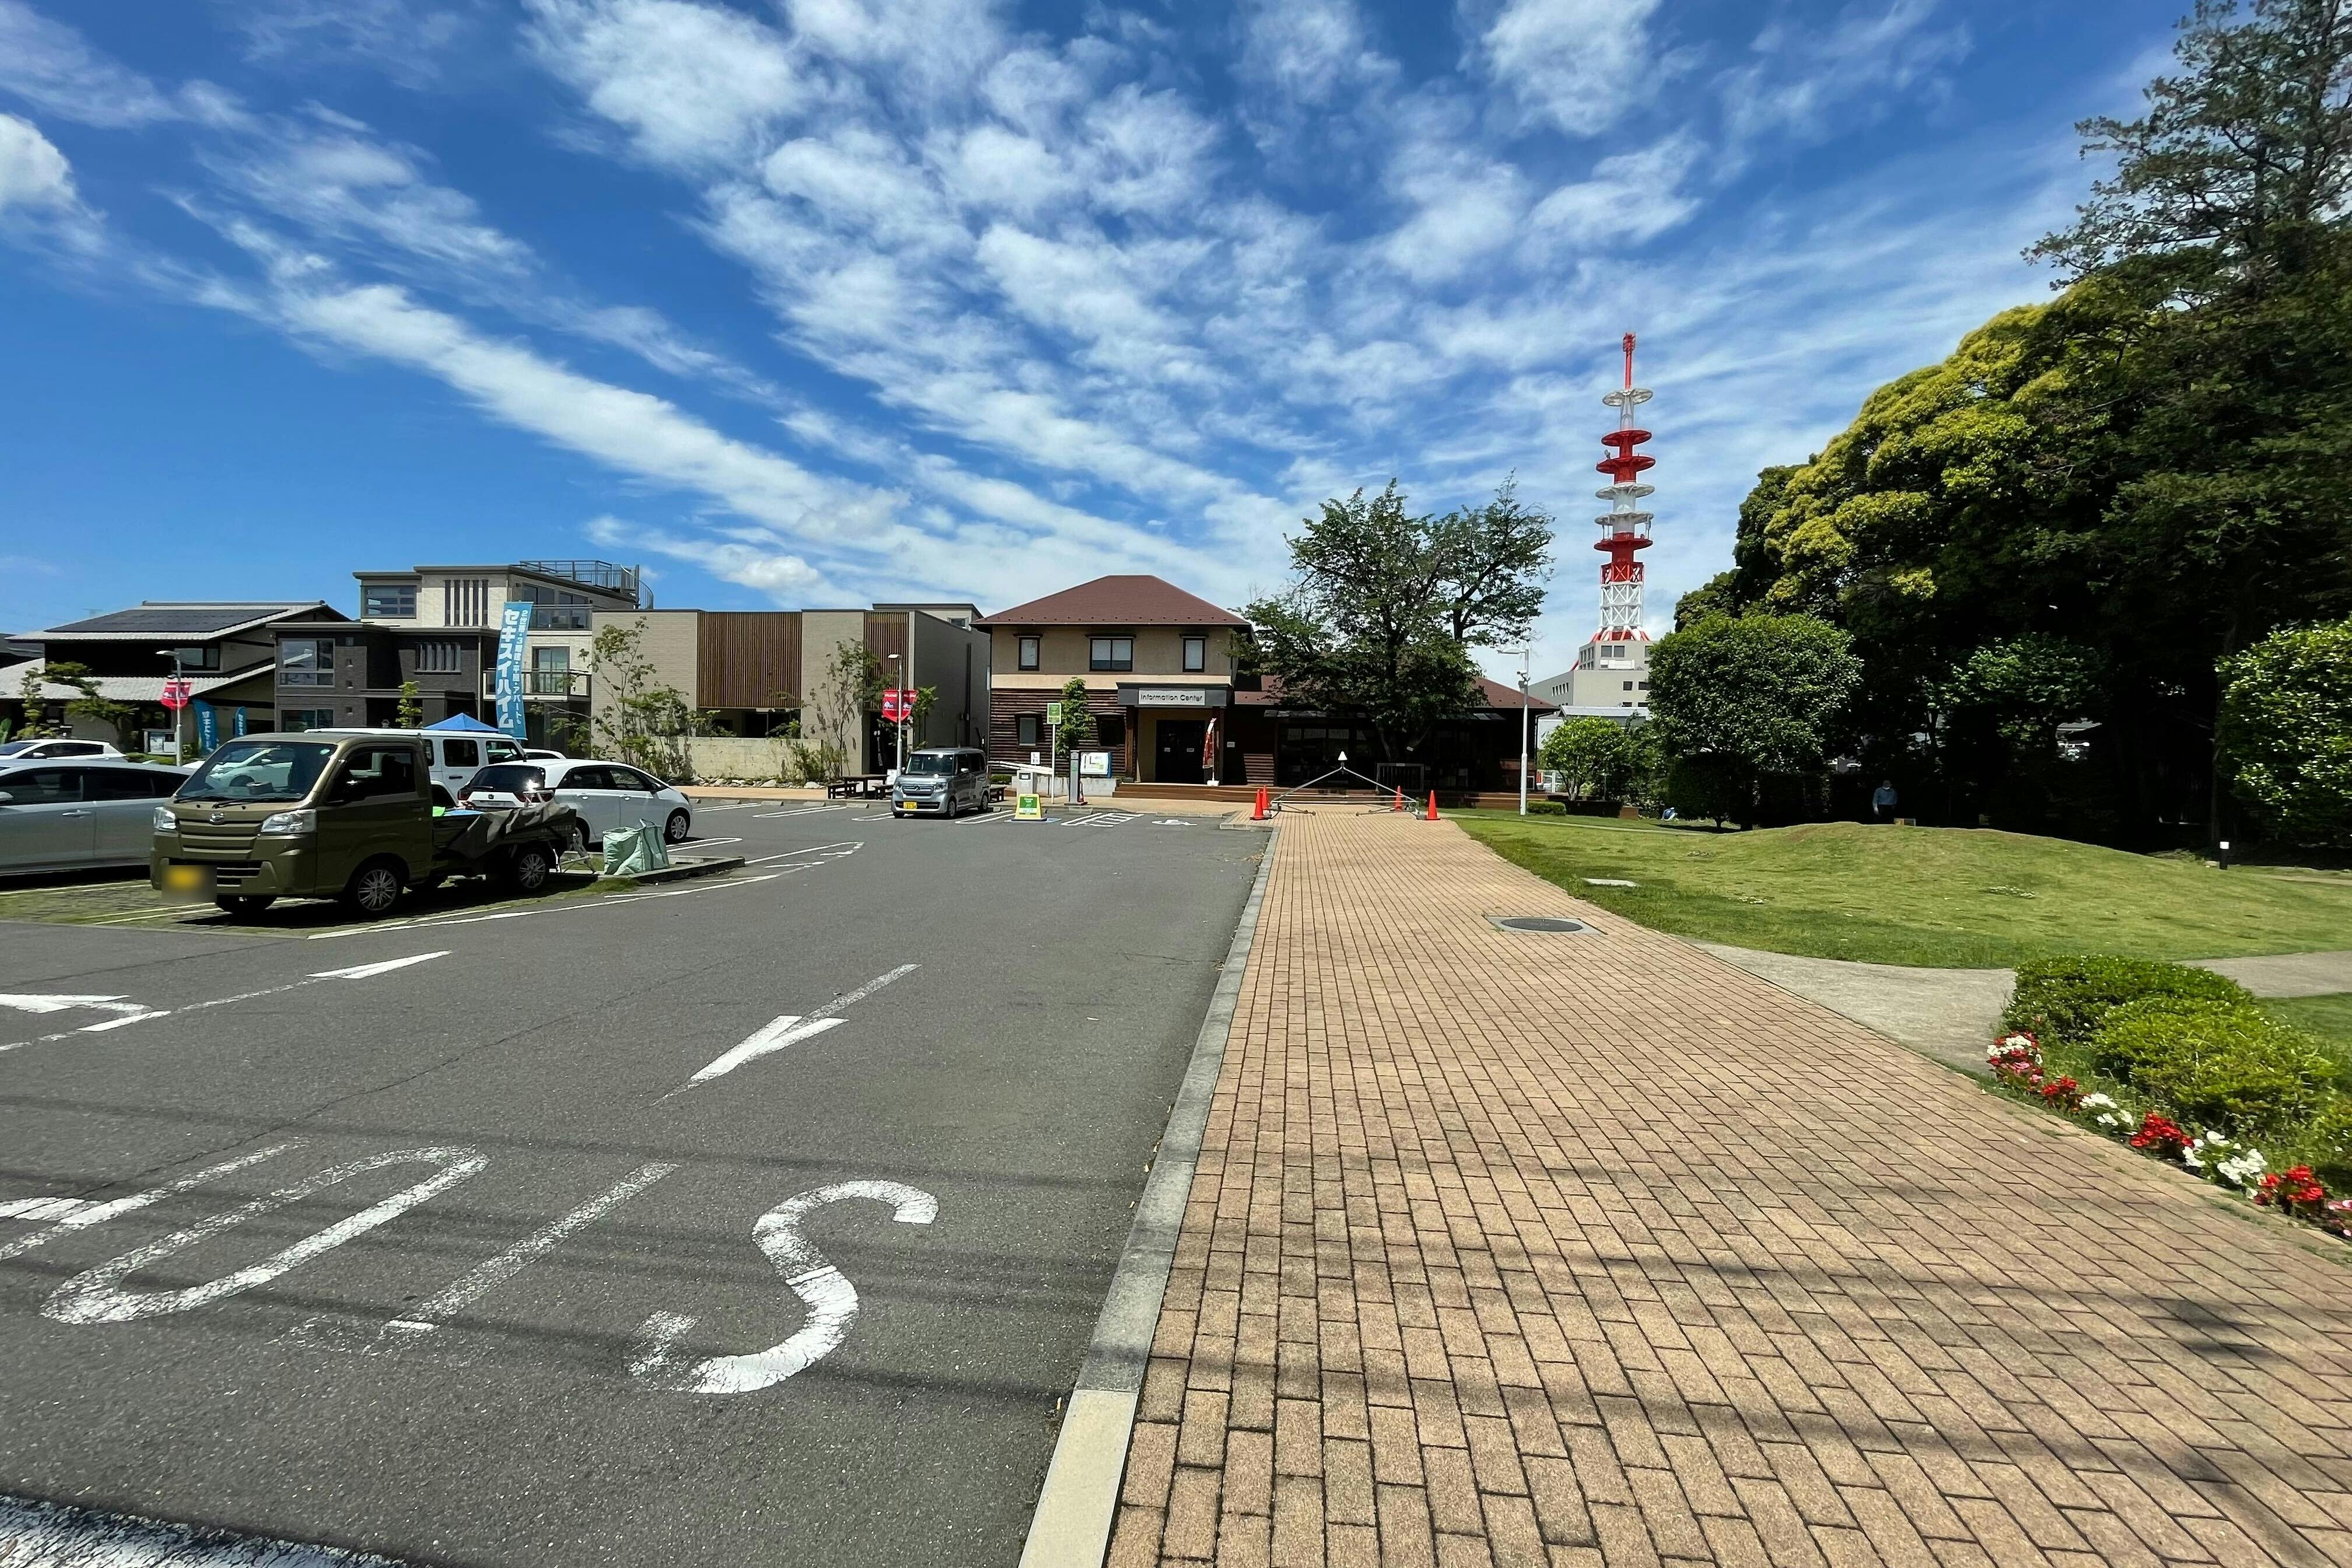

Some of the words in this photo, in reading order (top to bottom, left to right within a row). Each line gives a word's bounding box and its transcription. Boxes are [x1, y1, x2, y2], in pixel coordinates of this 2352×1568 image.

[497, 609, 520, 729] セキスイハイム
